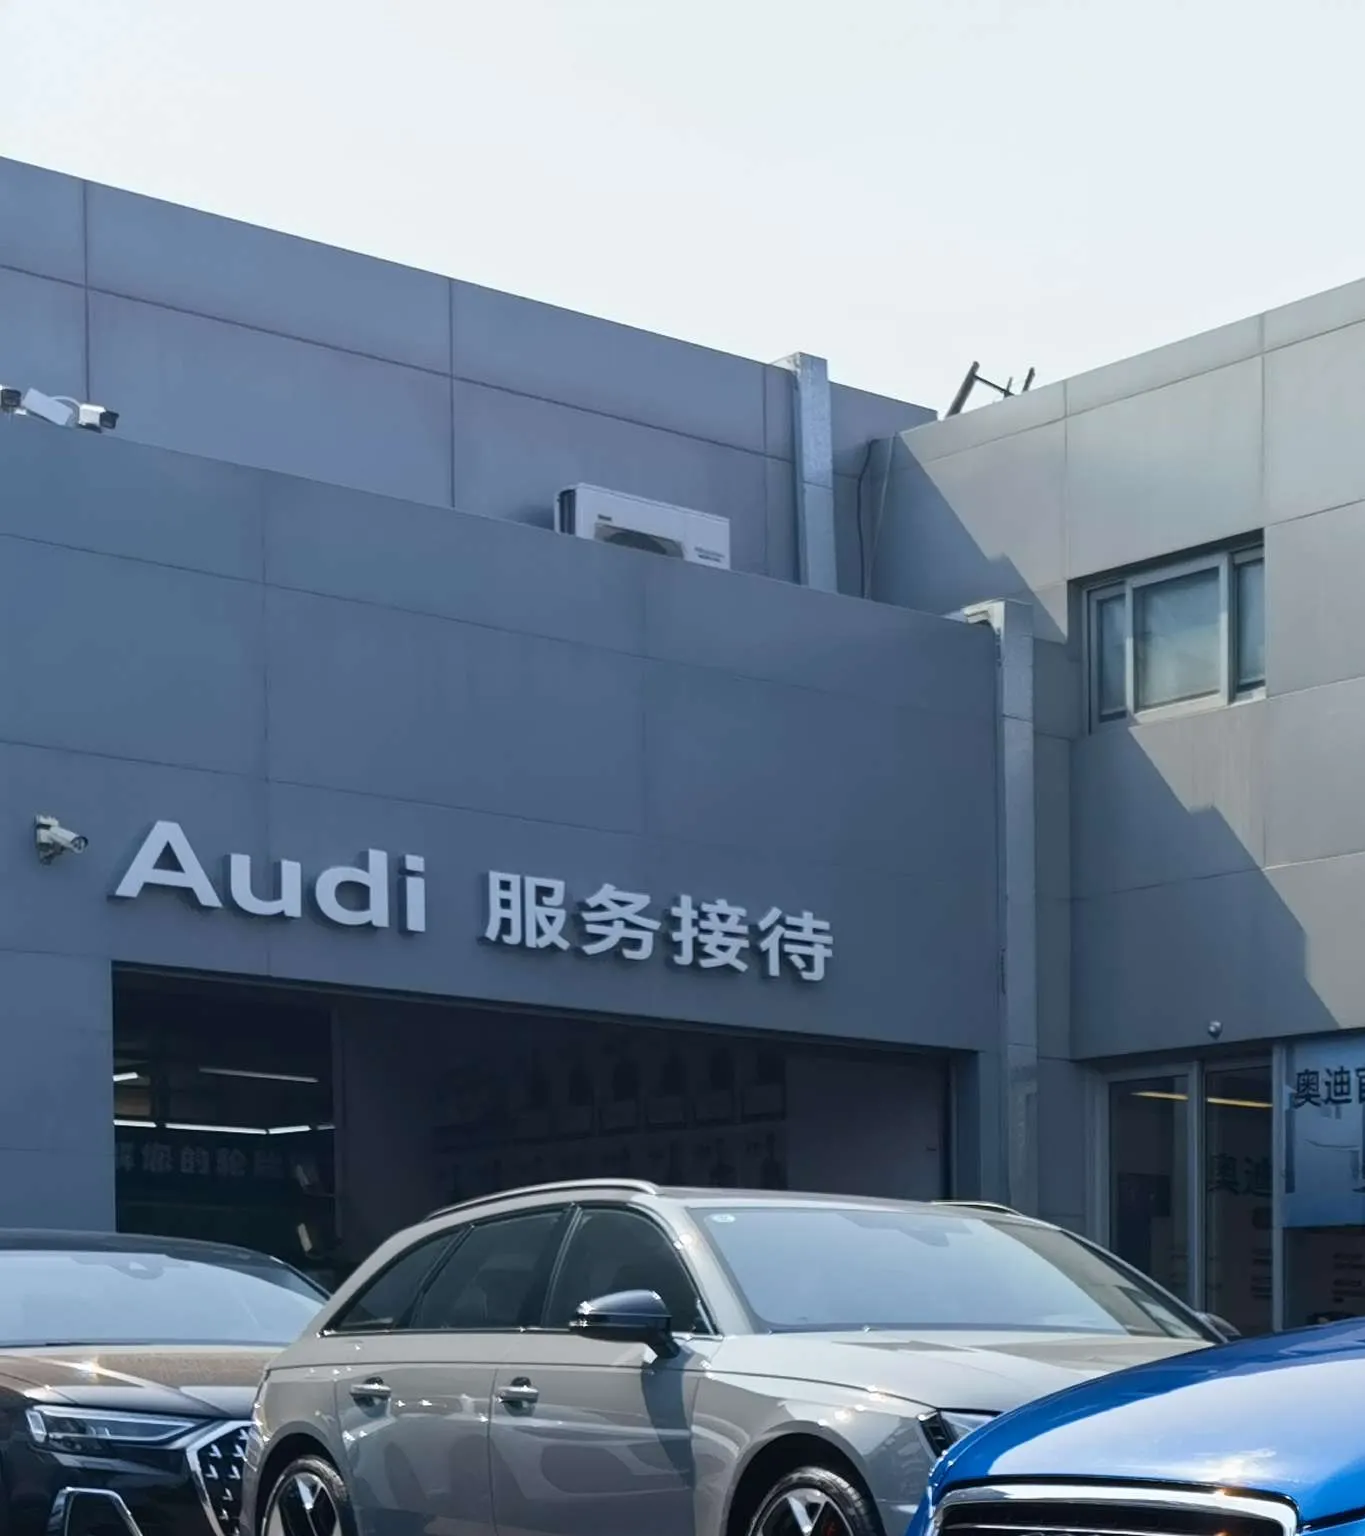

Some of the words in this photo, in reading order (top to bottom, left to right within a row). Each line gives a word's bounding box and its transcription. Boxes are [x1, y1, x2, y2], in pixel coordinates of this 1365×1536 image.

[113, 820, 426, 932] Audi
[484, 870, 835, 983] 服务接待
